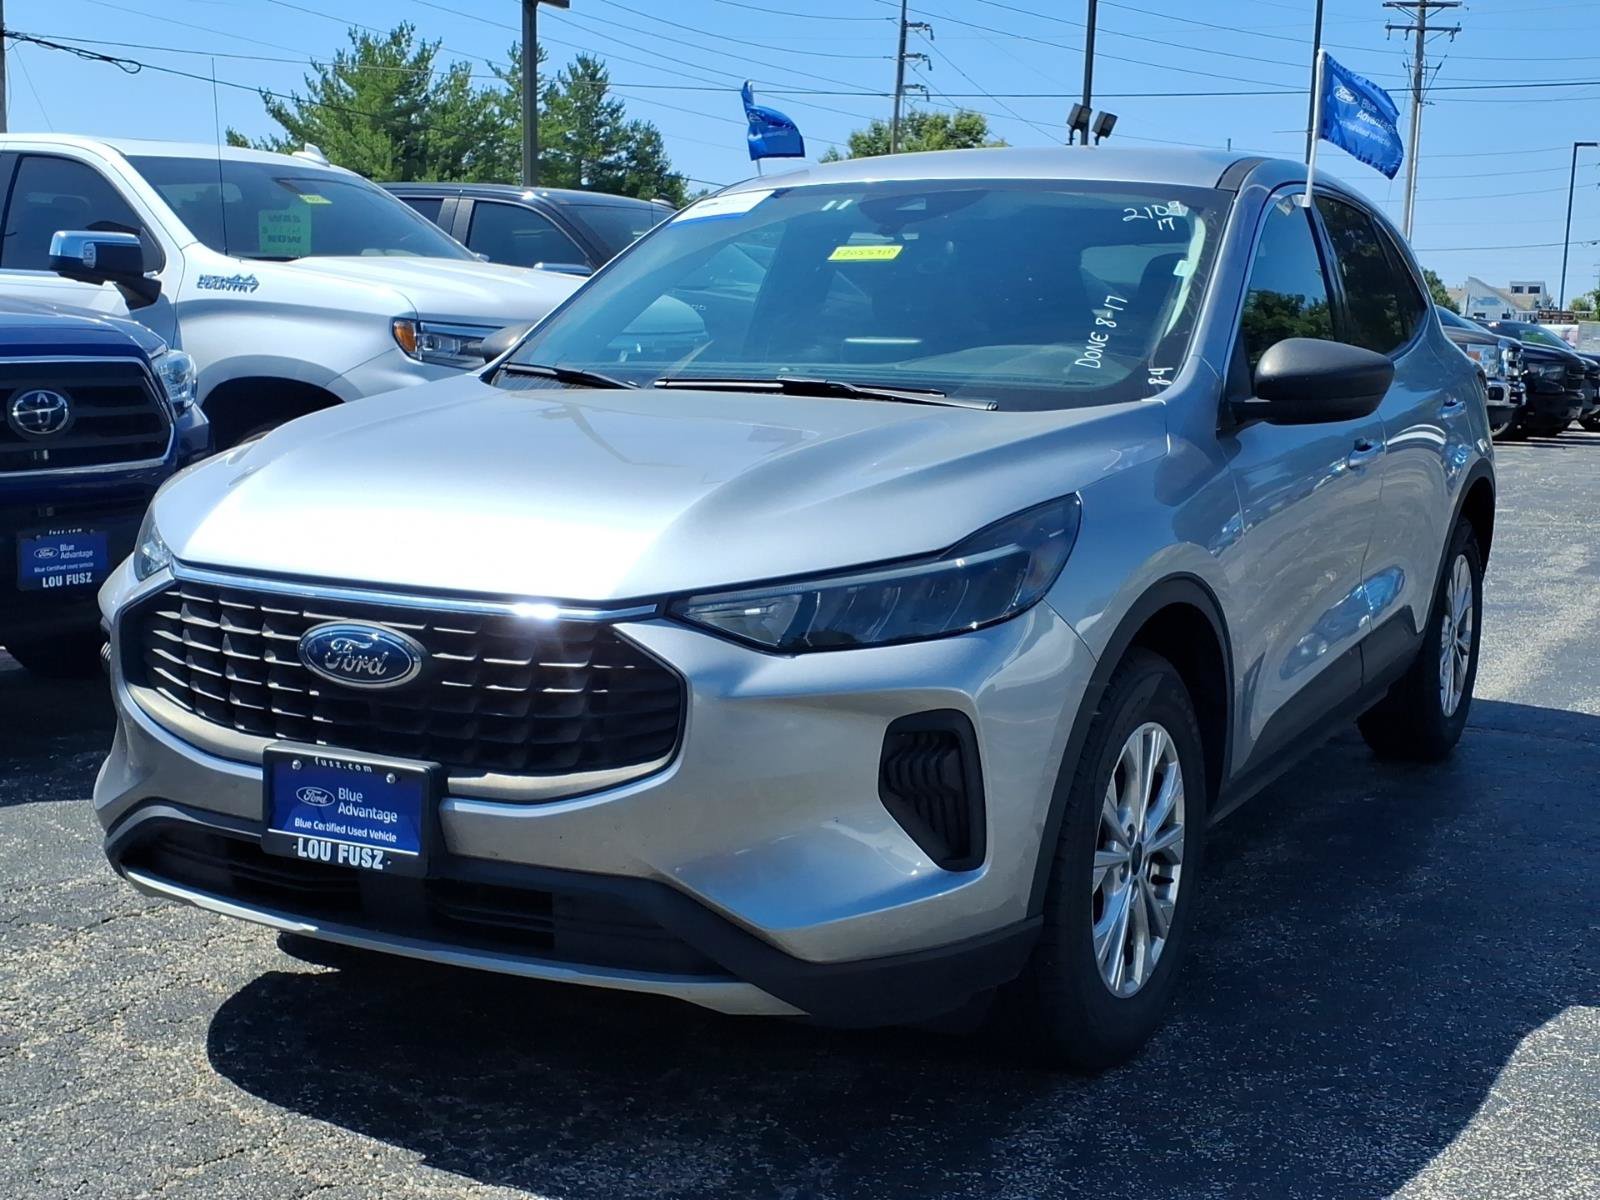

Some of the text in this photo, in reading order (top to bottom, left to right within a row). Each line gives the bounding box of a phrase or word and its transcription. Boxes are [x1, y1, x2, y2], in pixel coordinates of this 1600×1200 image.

[1361, 98, 1378, 114] Blue
[1157, 217, 1175, 231] 17
[1075, 295, 1129, 369] DONE 8-17
[60, 544, 74, 552] Blue
[60, 550, 94, 559] Advantage
[42, 572, 92, 588] LOU FUSZ
[325, 638, 389, 675] Ford
[314, 756, 373, 773] fusz.com
[338, 787, 363, 803] Blue
[338, 803, 398, 824] Advantage
[294, 817, 397, 843] Blue Certified Used Vehicle
[297, 837, 384, 870] LOU FUSZ
